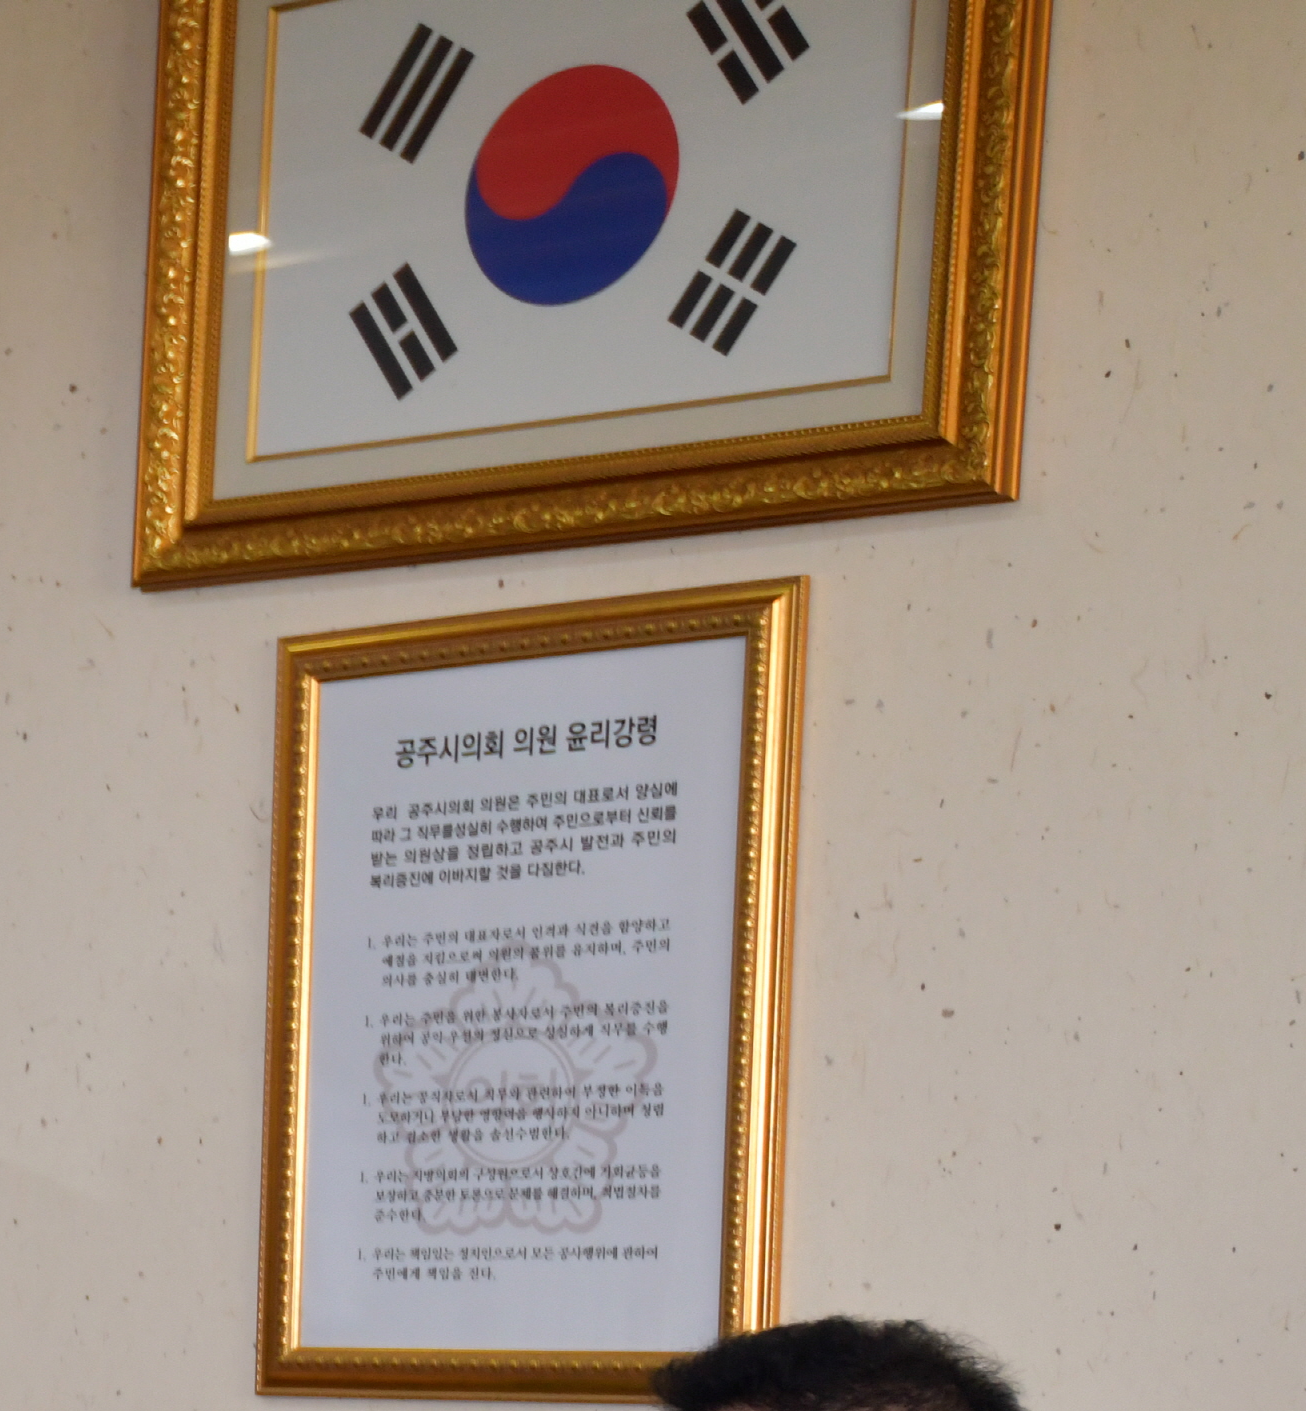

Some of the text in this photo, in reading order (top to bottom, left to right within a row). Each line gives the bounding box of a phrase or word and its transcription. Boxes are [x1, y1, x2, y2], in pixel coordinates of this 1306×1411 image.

[395, 715, 658, 769] 공주시의회 의원 윤리강령
